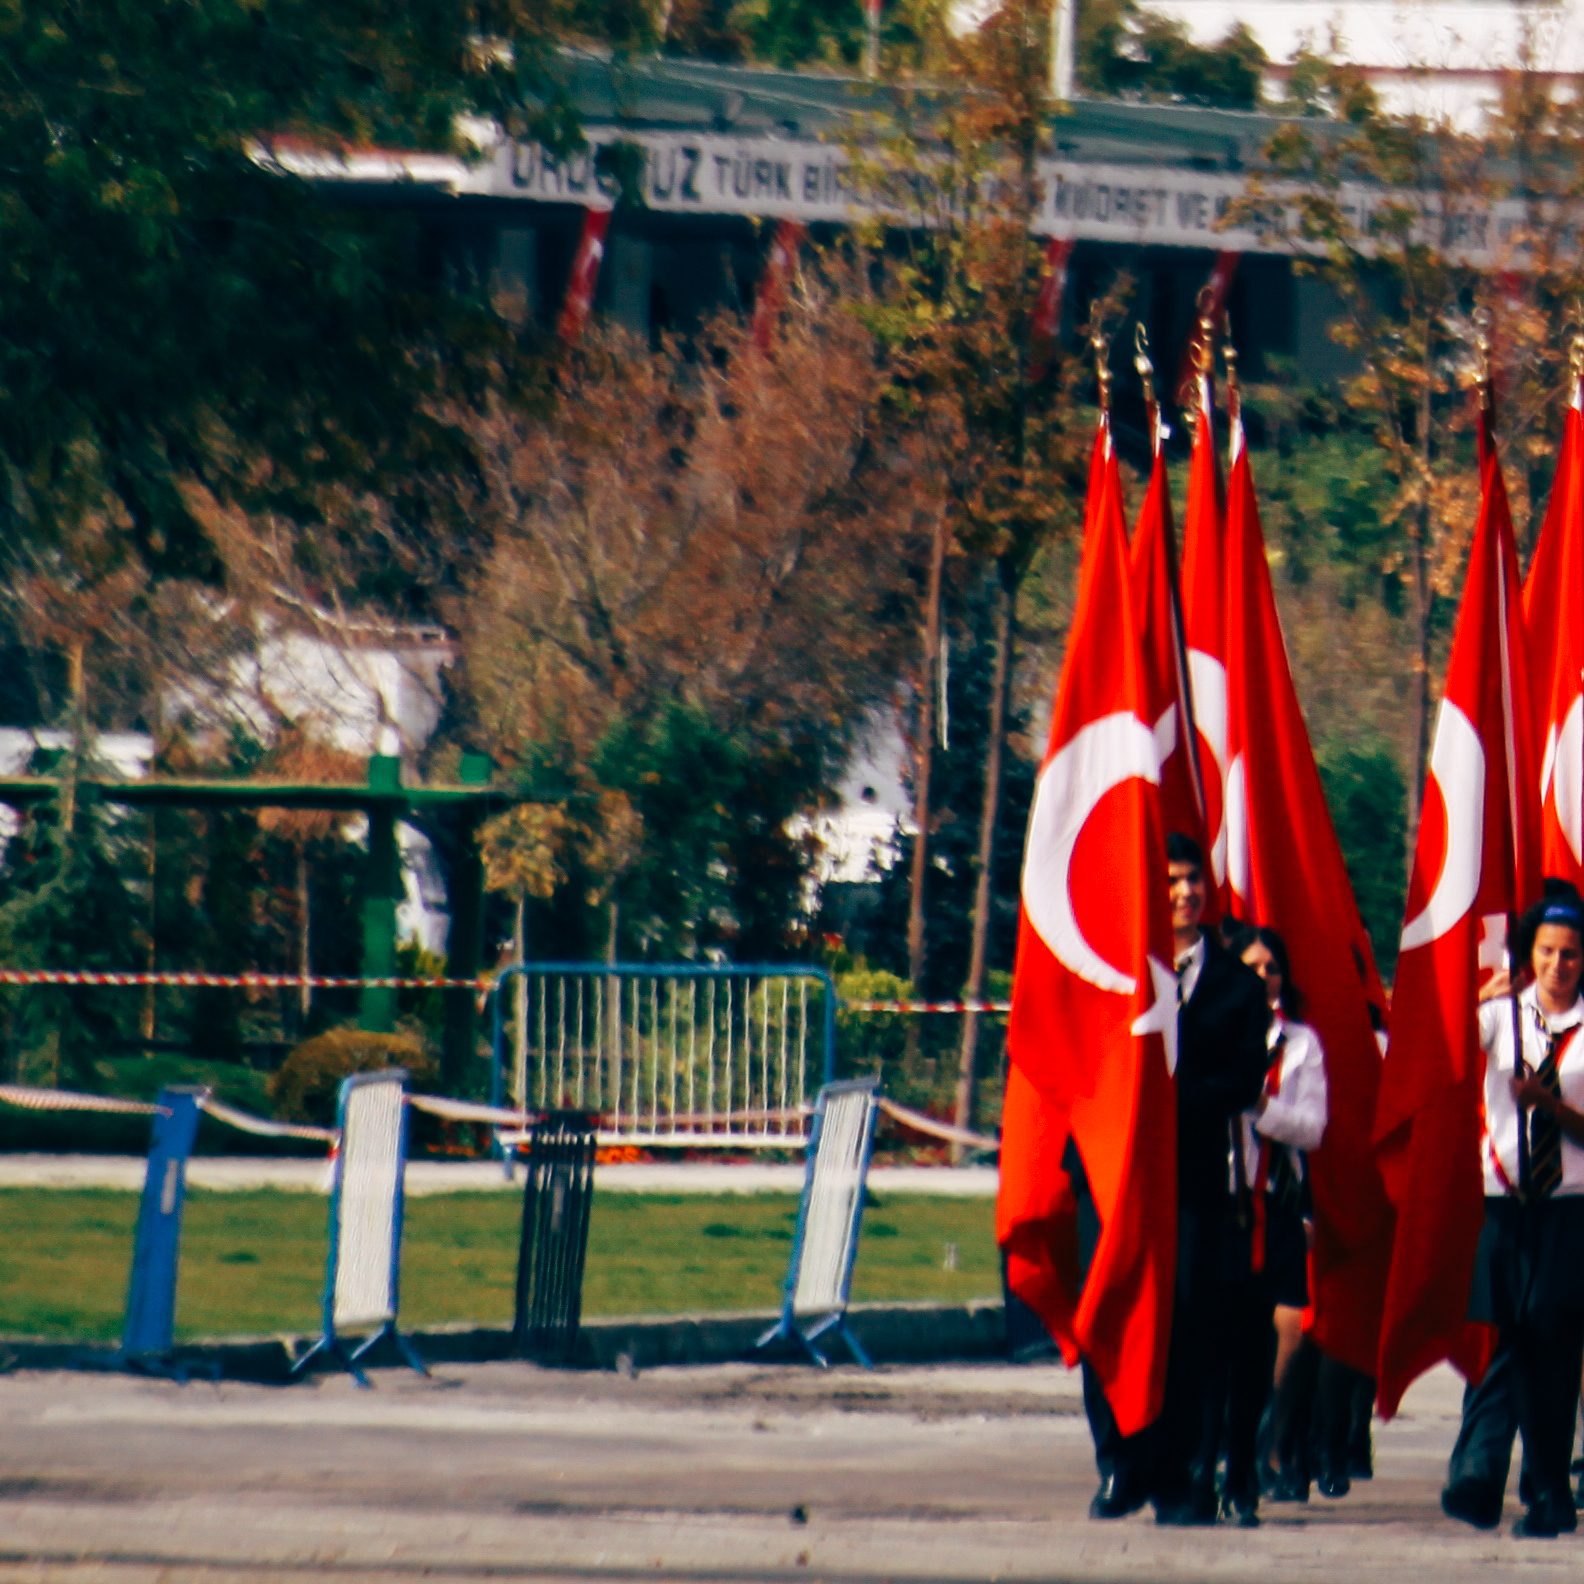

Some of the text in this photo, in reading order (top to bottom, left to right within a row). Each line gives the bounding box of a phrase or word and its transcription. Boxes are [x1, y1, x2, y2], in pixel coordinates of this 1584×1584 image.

[509, 136, 701, 201] ORDUZ
[712, 149, 791, 201] TÜRK
[1177, 190, 1208, 230] VE
